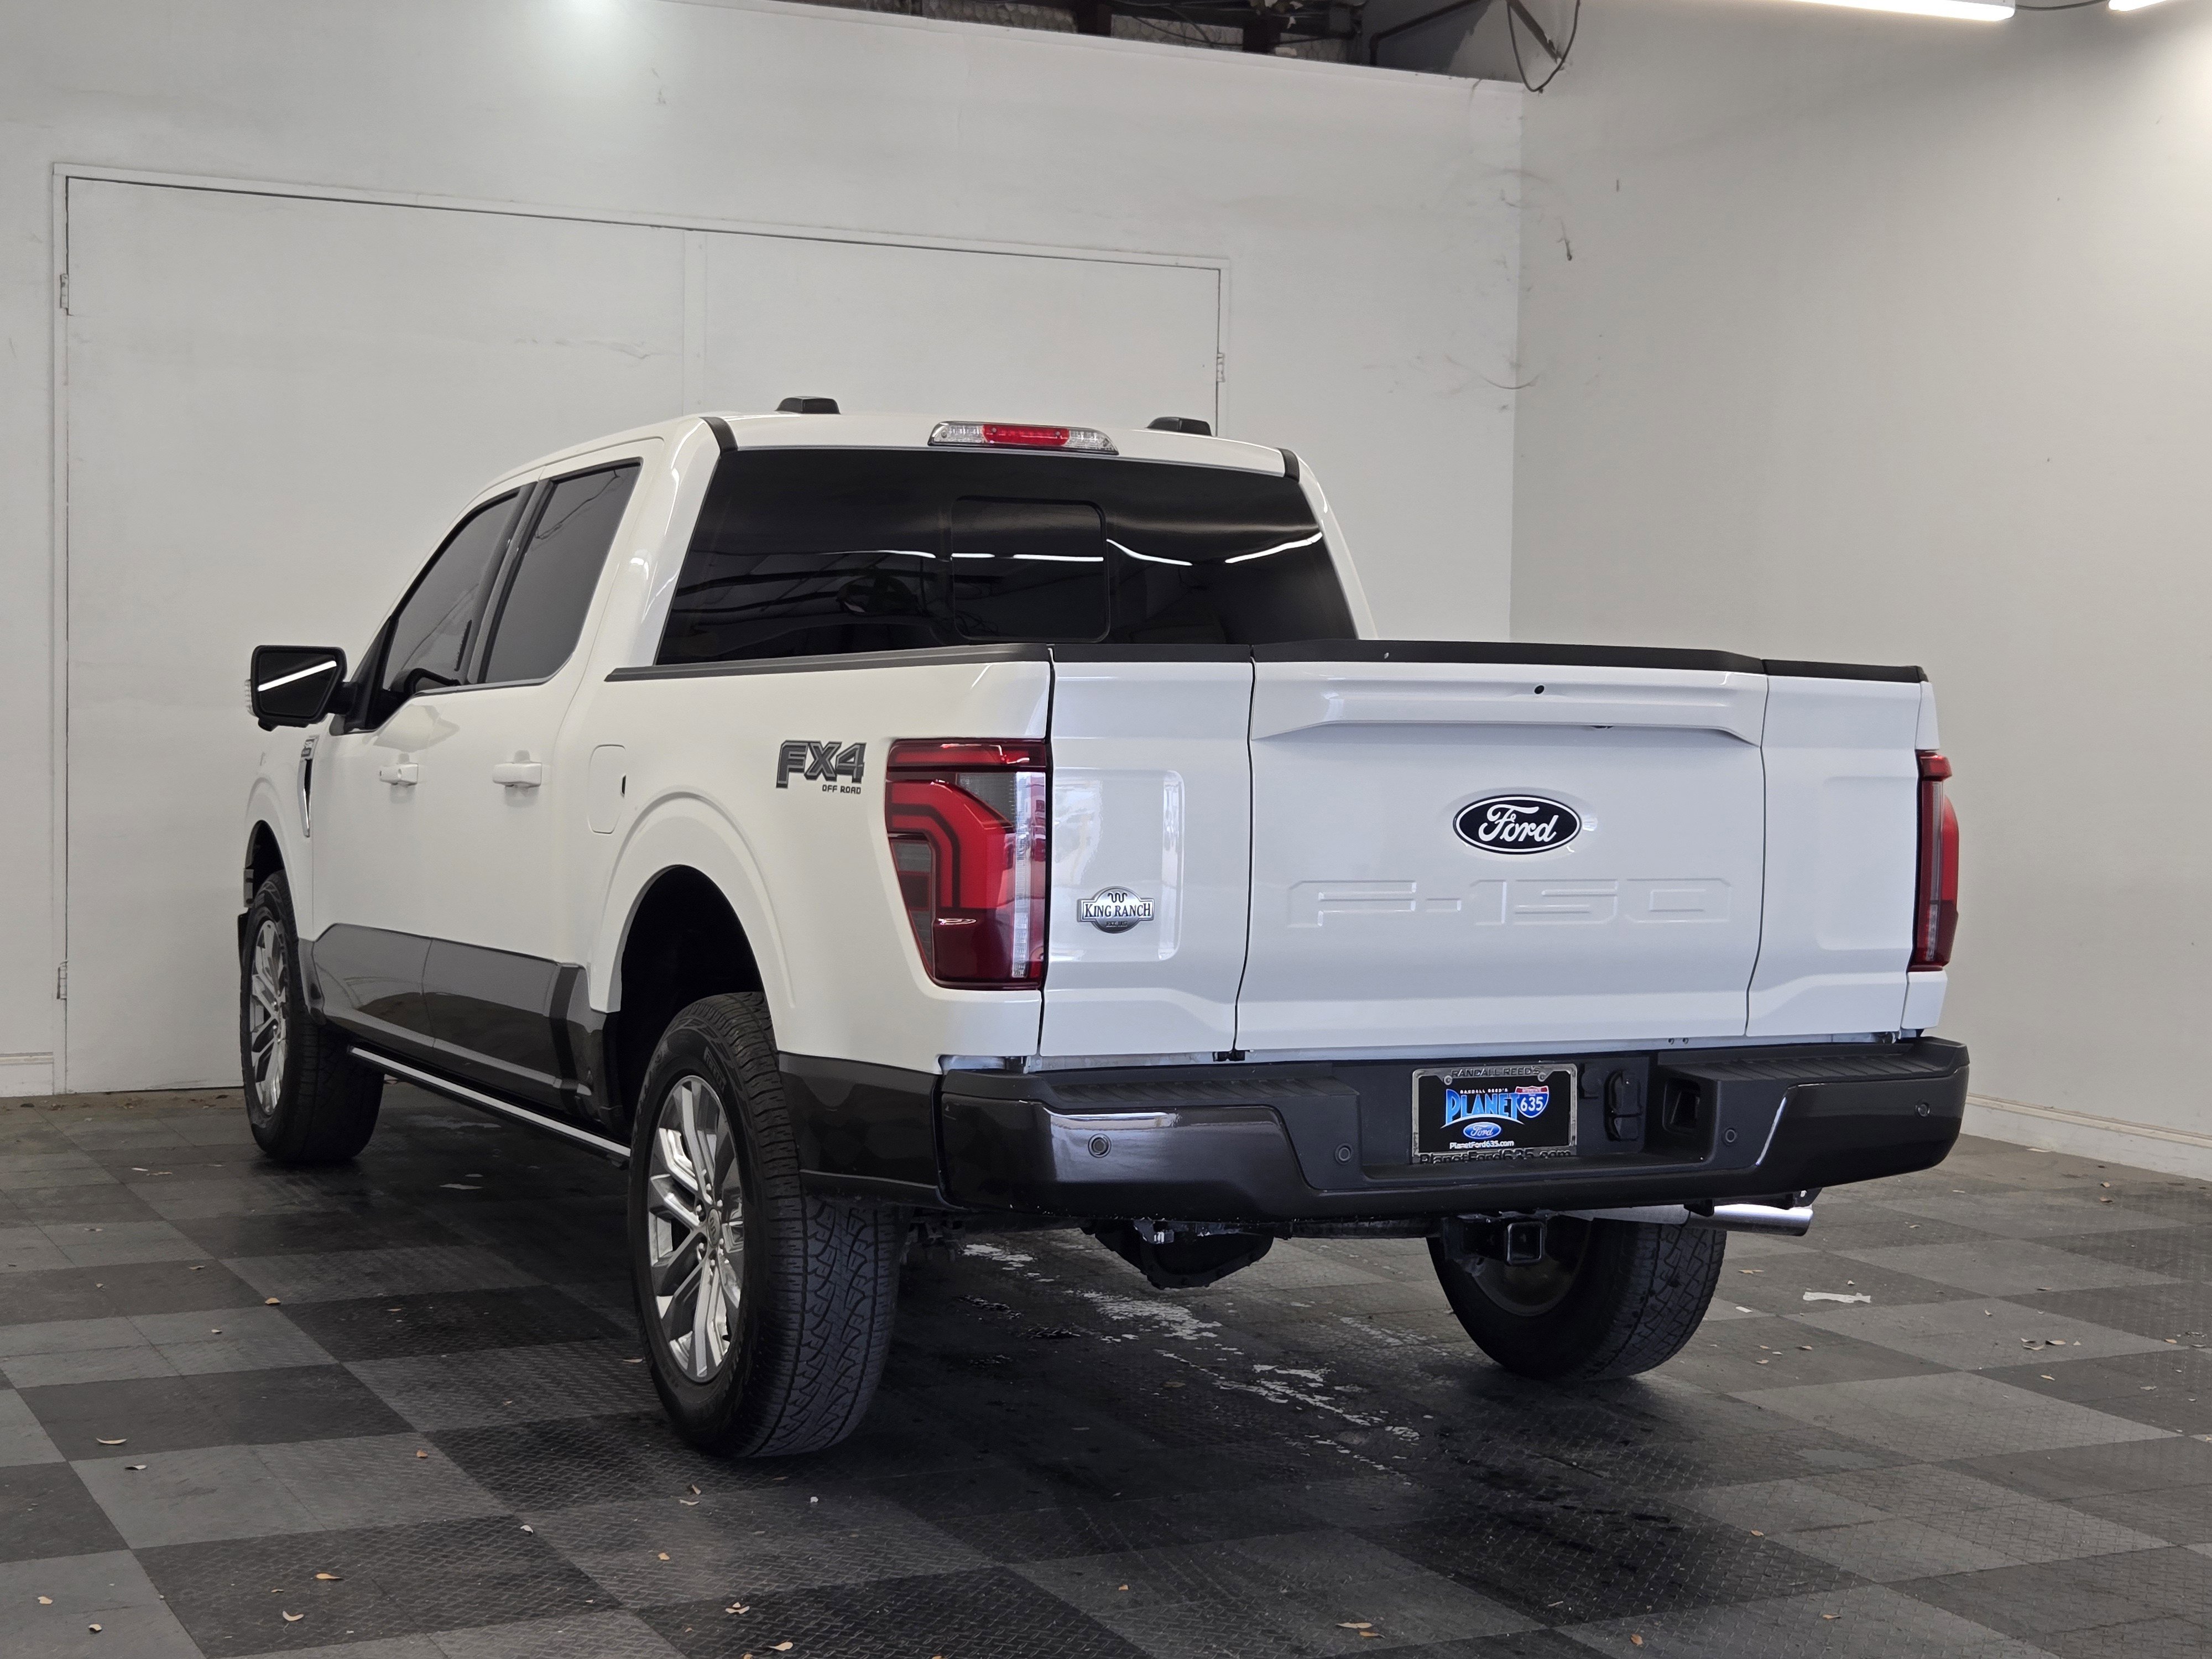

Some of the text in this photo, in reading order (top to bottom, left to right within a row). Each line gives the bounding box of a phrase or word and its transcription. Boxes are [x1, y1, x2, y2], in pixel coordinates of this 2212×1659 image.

[776, 739, 867, 789] FX4
[822, 784, 862, 795] OFF ROAD
[1478, 804, 1559, 842] Ford
[1084, 902, 1151, 917] KING RANCH
[1287, 878, 1732, 928] F-150
[1451, 1068, 1501, 1077] RANDALL
[1445, 1088, 1520, 1124] PLANET
[1520, 1096, 1543, 1112] 635
[1470, 1124, 1494, 1137] Ford
[1449, 1140, 1515, 1150] PlanetFord635.com
